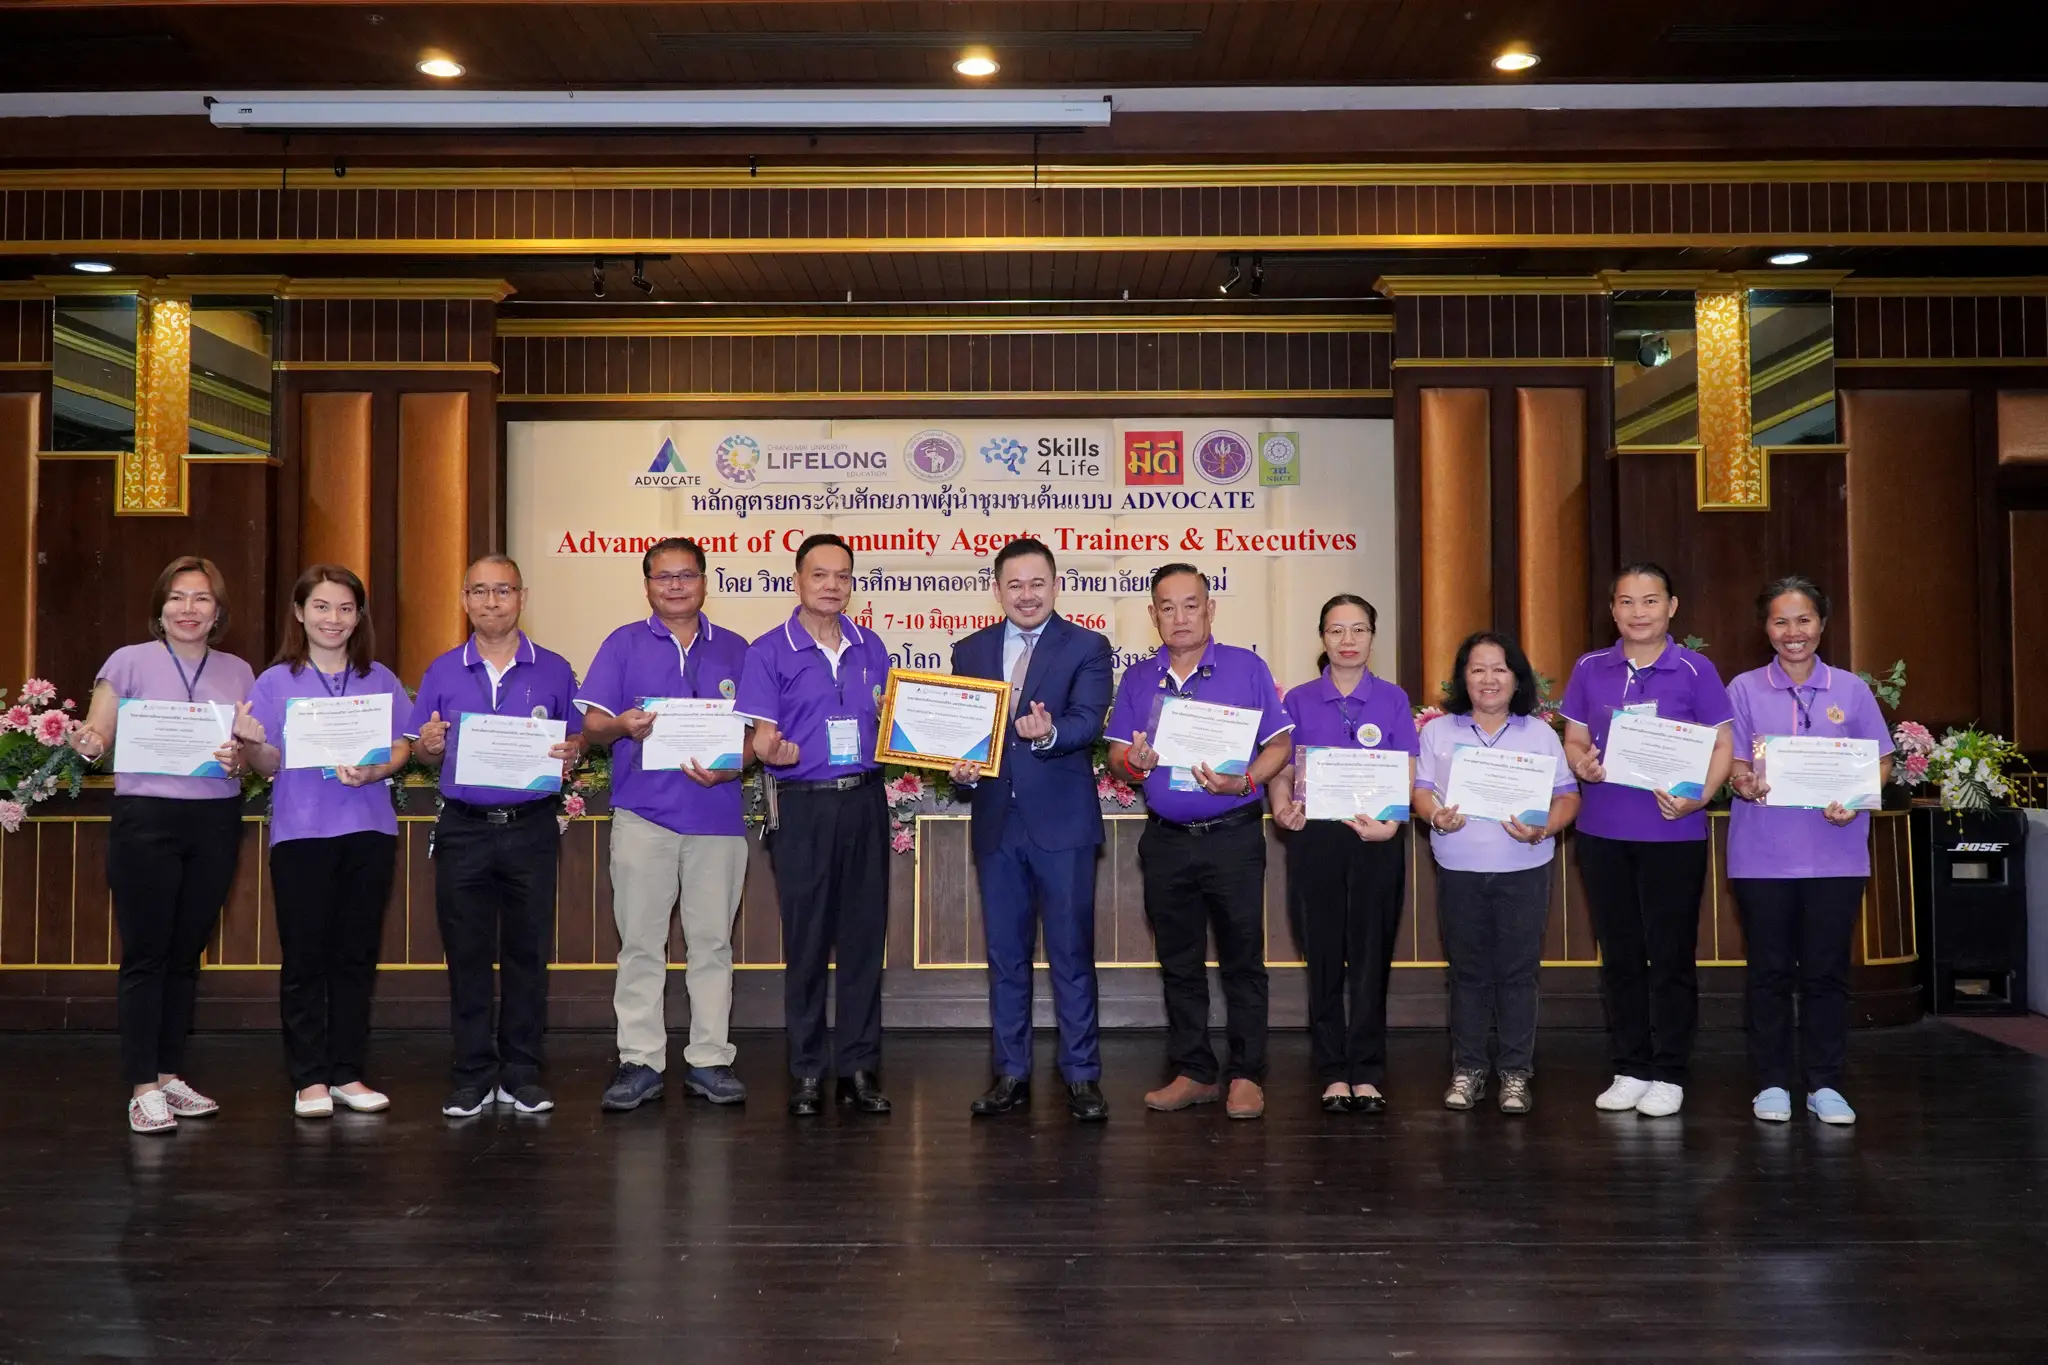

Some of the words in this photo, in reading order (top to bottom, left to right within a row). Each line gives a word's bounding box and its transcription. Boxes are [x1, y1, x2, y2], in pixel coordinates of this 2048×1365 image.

[1037, 437, 1100, 457] Skills
[767, 451, 887, 470] LIFELONG
[1037, 460, 1051, 476] 4
[1058, 459, 1100, 476] Life
[1128, 440, 1178, 476] มีดี
[634, 475, 701, 486] ADVOCATE
[1120, 491, 1256, 510] ADVOCATE
[556, 529, 739, 554] Advancent
[747, 529, 776, 553] of
[782, 527, 941, 557] Cmunity
[1054, 527, 1170, 552] Trainers
[1179, 527, 1205, 552] &
[1214, 528, 1357, 552] Executives
[715, 566, 753, 593] โดย
[1946, 842, 2010, 852] BOSE
